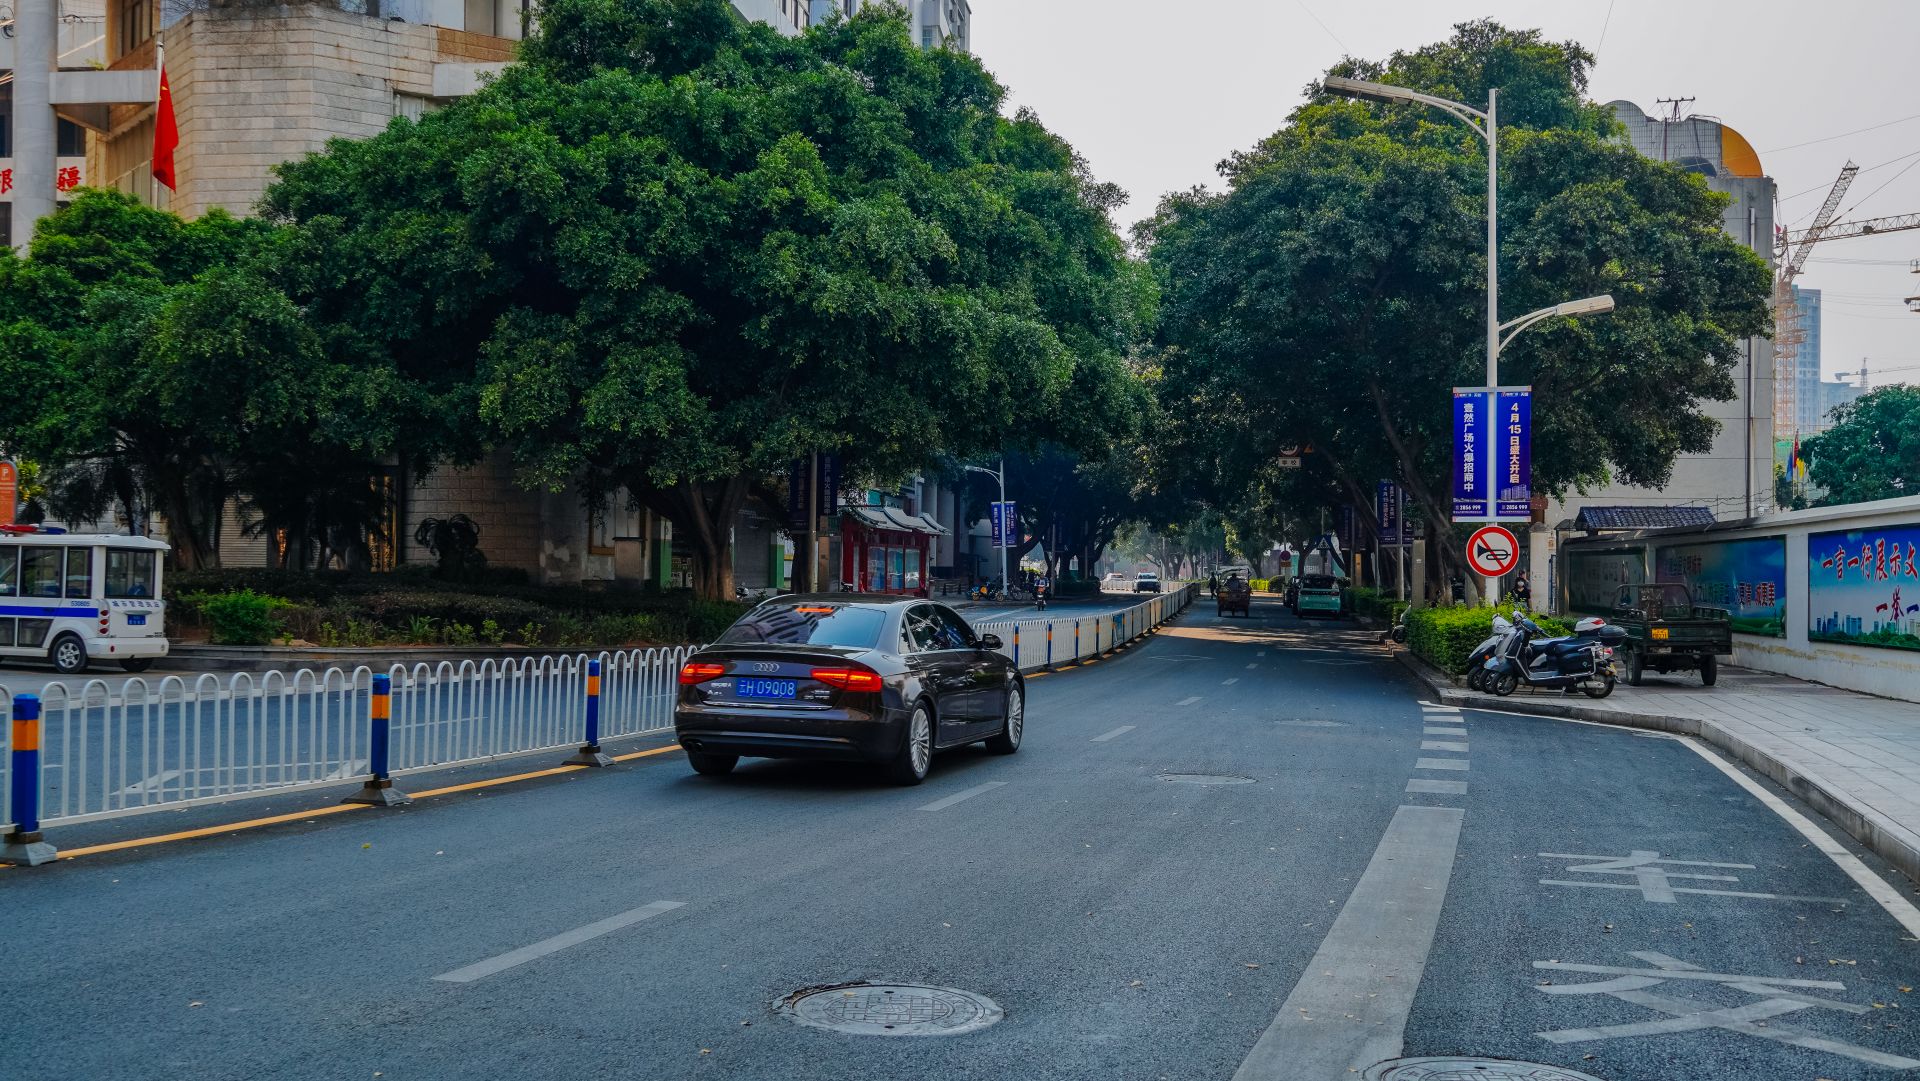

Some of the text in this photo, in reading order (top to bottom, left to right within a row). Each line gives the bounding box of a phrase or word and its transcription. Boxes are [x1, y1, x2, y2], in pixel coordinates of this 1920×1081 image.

[1463, 402, 1474, 492] 壹然广场火爆招商中
[1508, 402, 1521, 484] 4月15日盛大开启
[1822, 538, 1918, 582] 一言一行展示文
